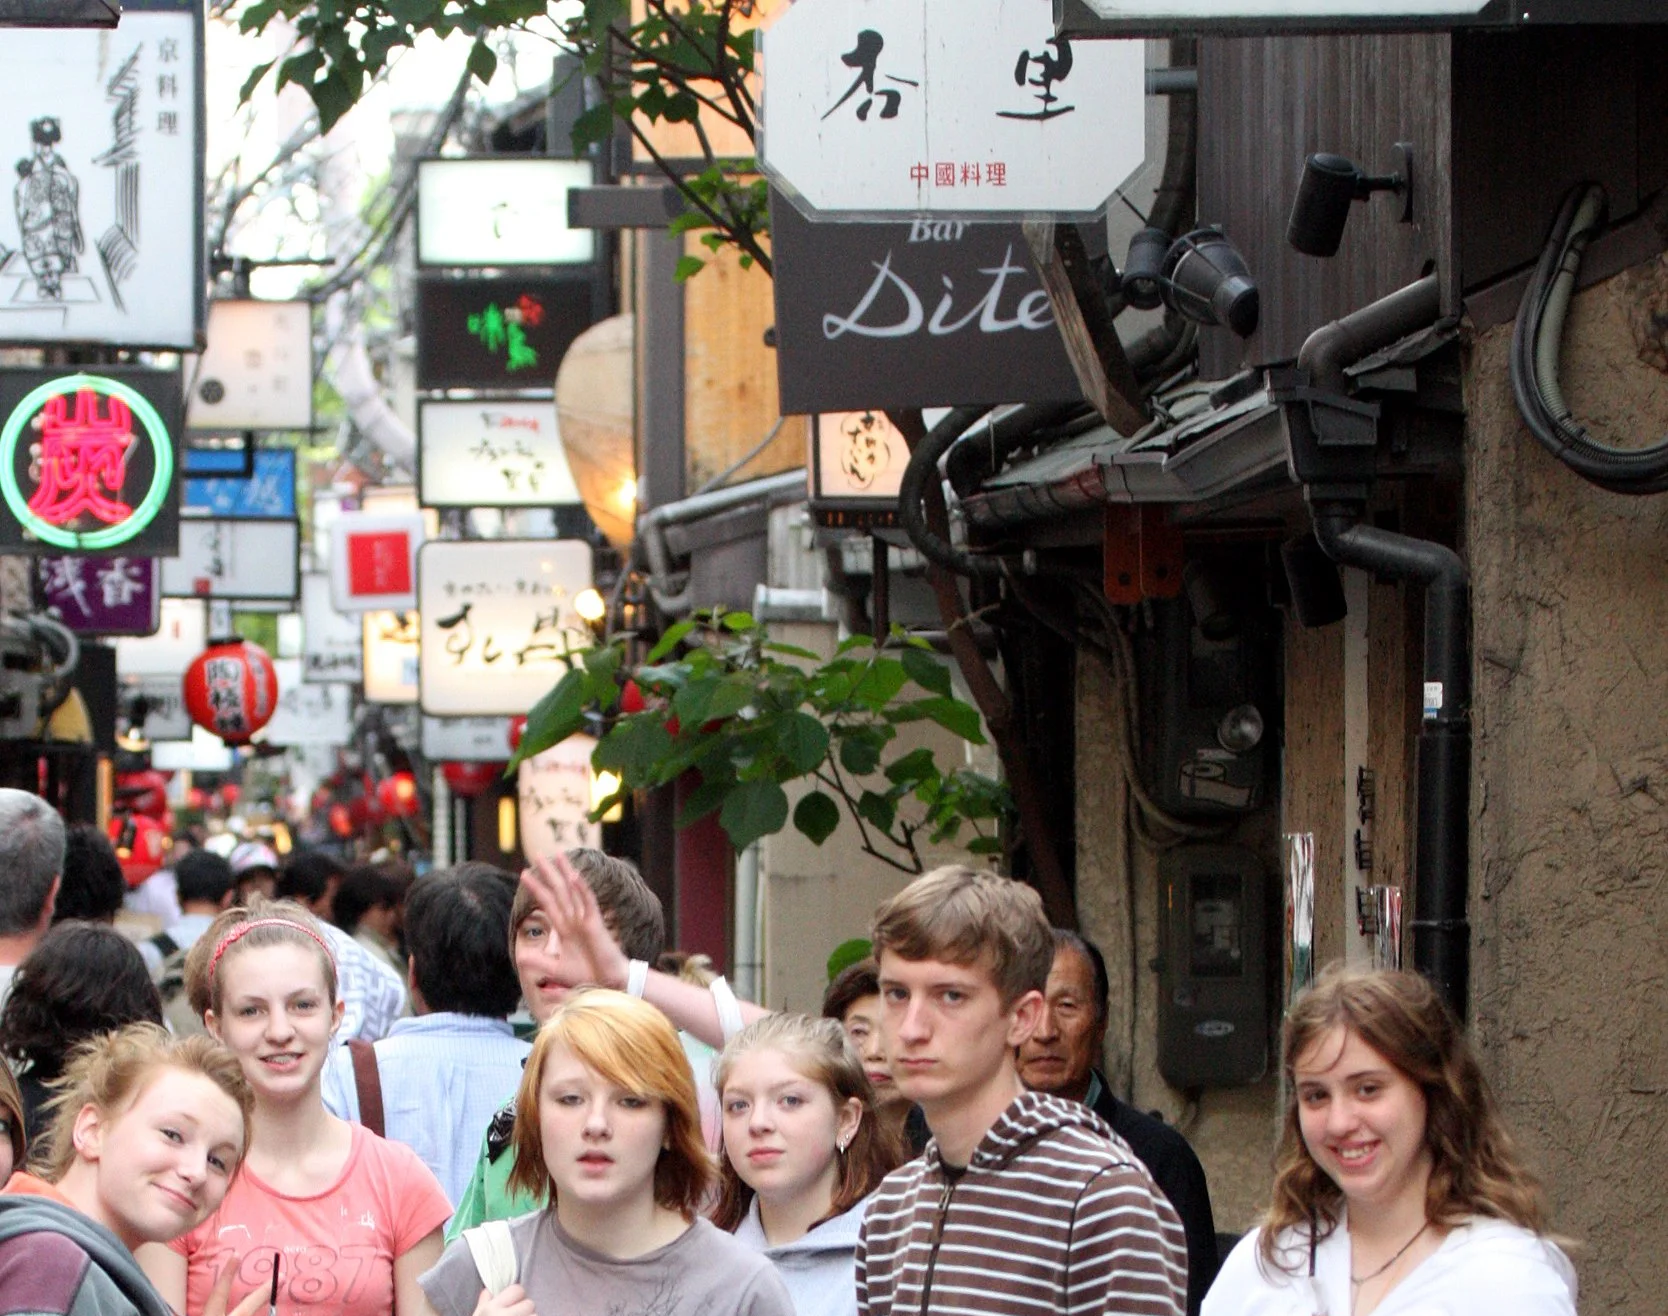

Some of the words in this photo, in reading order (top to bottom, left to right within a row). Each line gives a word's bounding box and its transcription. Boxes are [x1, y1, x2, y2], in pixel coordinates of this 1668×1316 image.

[157, 37, 179, 136] 京料理
[910, 161, 1007, 188] 中國料理
[907, 218, 972, 244] Bar
